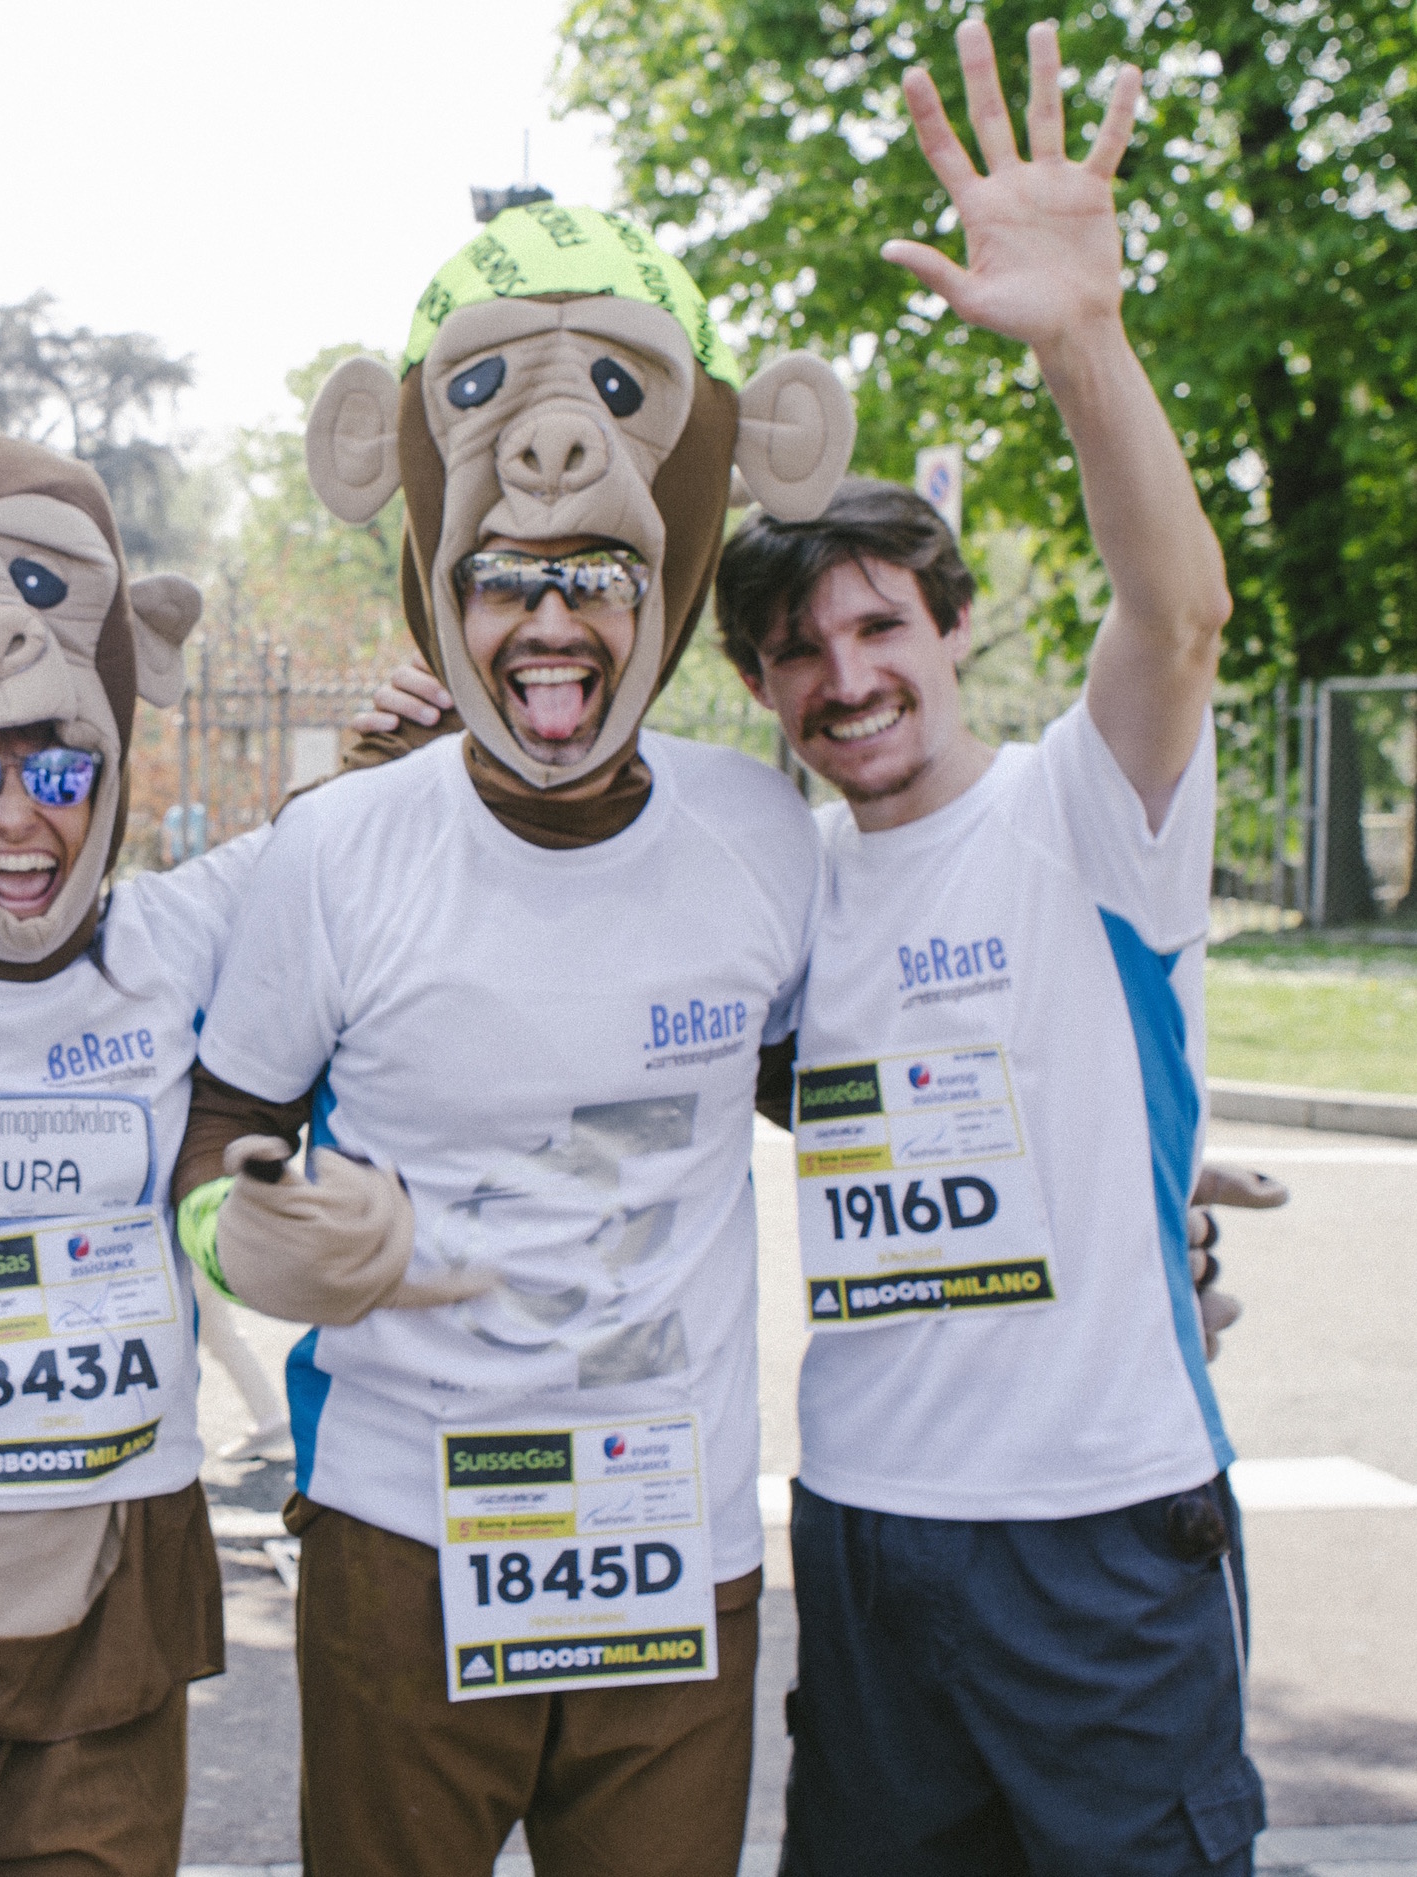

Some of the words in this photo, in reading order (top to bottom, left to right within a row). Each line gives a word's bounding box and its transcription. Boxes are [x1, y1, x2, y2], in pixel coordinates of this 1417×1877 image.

[898, 936, 1008, 992] .BeRare
[644, 999, 747, 1050] .BeRare
[42, 1028, 155, 1082] .BeRare
[825, 1176, 999, 1241] 1916D
[468, 1541, 683, 1607] 1845D
